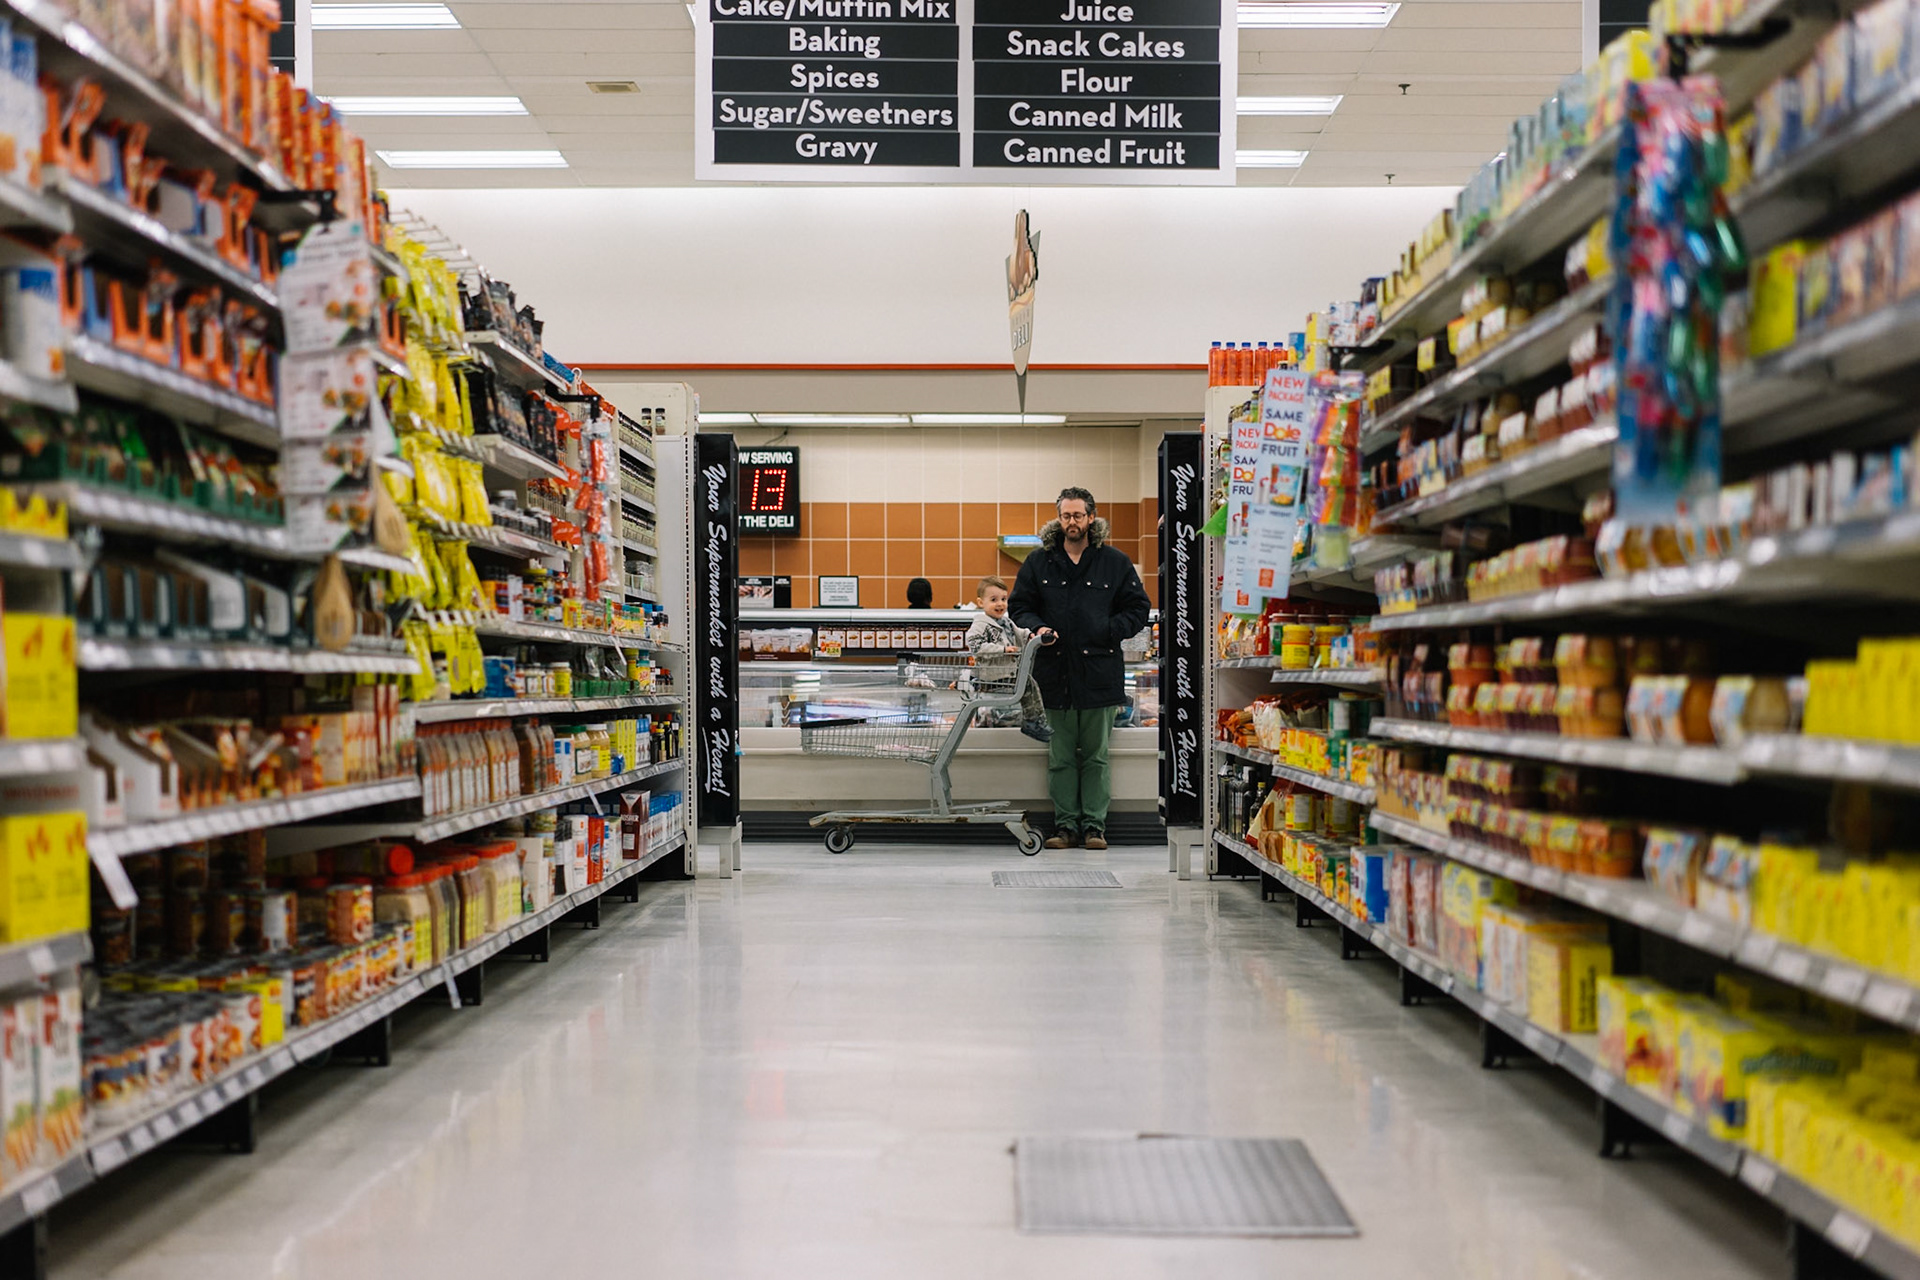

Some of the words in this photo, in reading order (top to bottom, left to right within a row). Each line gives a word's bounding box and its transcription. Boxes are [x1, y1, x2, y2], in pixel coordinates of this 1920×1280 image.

[715, 0, 892, 21] Cake/Muffin
[900, 0, 950, 19] Mix
[1060, 0, 1134, 22] Juice
[788, 26, 881, 59] Baking
[1006, 30, 1090, 57] Snack
[1098, 31, 1186, 58] Cakes
[790, 63, 880, 92] Spices
[1061, 68, 1133, 93] Flour
[719, 98, 954, 130] Sugar/Sweetners
[1008, 102, 1116, 128] Canned
[1125, 103, 1183, 129] Milk
[795, 133, 878, 165] Gravy
[1003, 139, 1111, 164] Canned
[1120, 140, 1186, 165] Fruit
[1012, 322, 1030, 352] DELI
[1272, 376, 1306, 389] NEW
[1268, 390, 1304, 403] PACKAGE
[1265, 408, 1304, 422] SAME
[1263, 422, 1301, 440] Dole
[751, 452, 793, 464] SERVING
[1233, 456, 1257, 465] SAM
[1261, 443, 1299, 458] FRUIT
[702, 463, 727, 512] Your
[1170, 463, 1195, 512] Your
[1233, 467, 1256, 482] Dol
[751, 469, 787, 511] 13
[1232, 485, 1254, 496] FRU
[744, 515, 767, 528] THE
[768, 515, 794, 528] DELI
[704, 521, 728, 647] Supermarket
[1171, 521, 1195, 647] Supermarket
[710, 656, 728, 698] with
[1177, 656, 1195, 699] with
[710, 707, 721, 721] a
[1177, 707, 1188, 722] a
[711, 728, 731, 797] Heart!
[1177, 729, 1197, 798] Heart!
